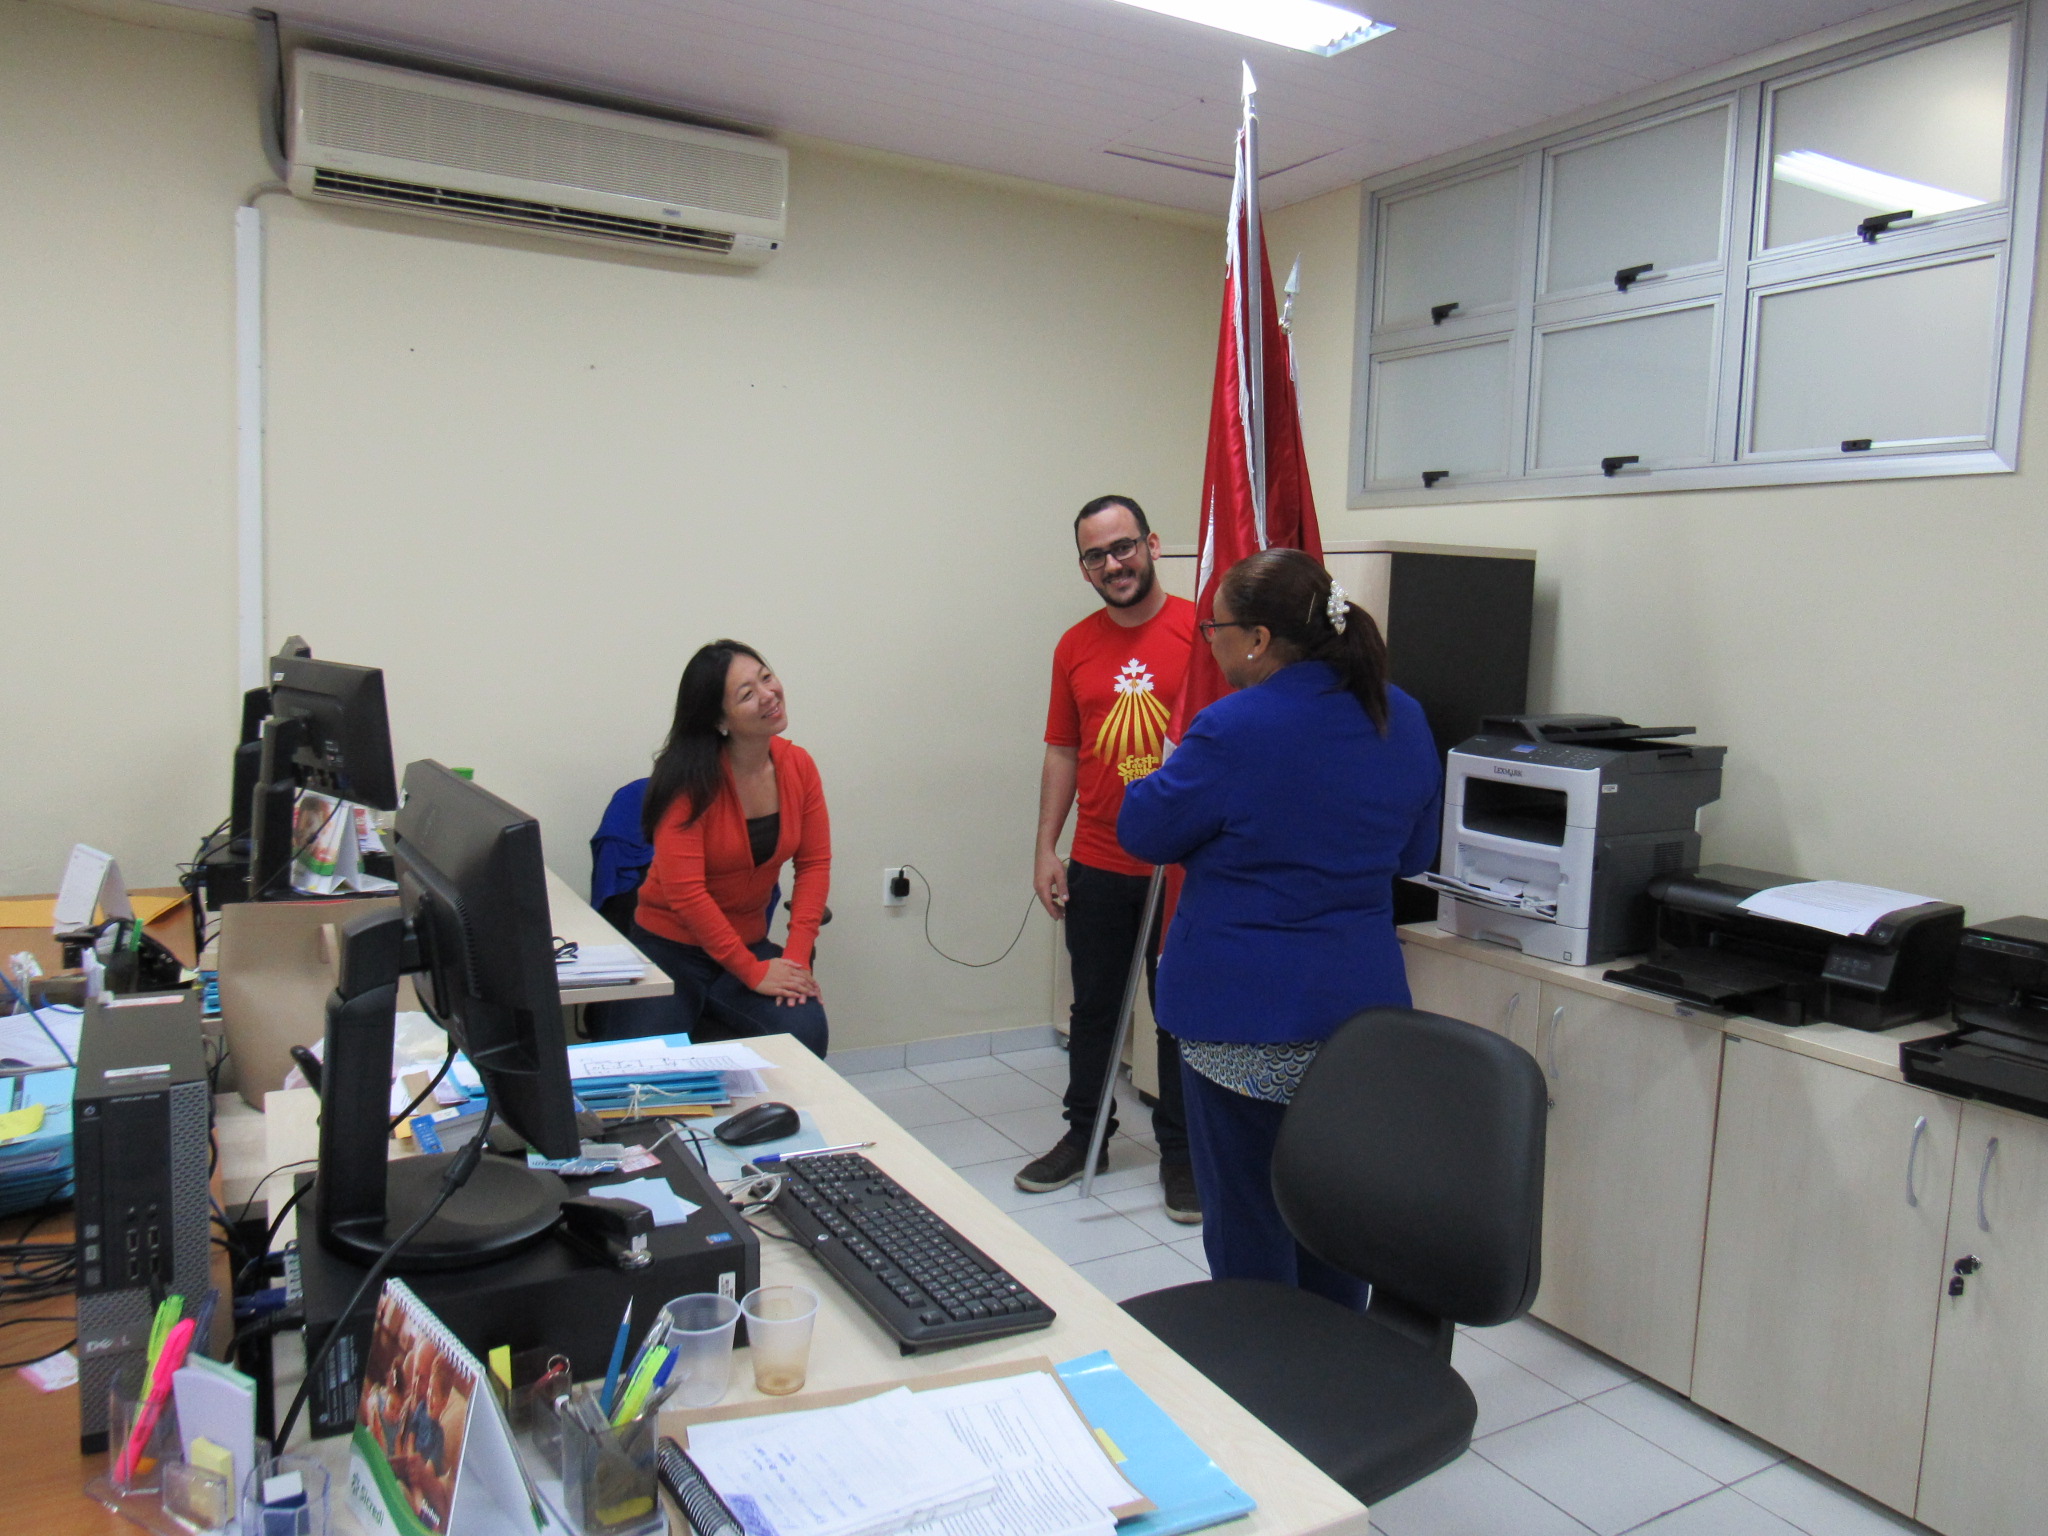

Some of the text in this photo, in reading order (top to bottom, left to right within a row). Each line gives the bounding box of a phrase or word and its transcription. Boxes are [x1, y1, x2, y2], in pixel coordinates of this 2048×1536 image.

[1126, 754, 1159, 768] Festa
[86, 1335, 131, 1352] DEL
[360, 1485, 385, 1527] Sicredi
